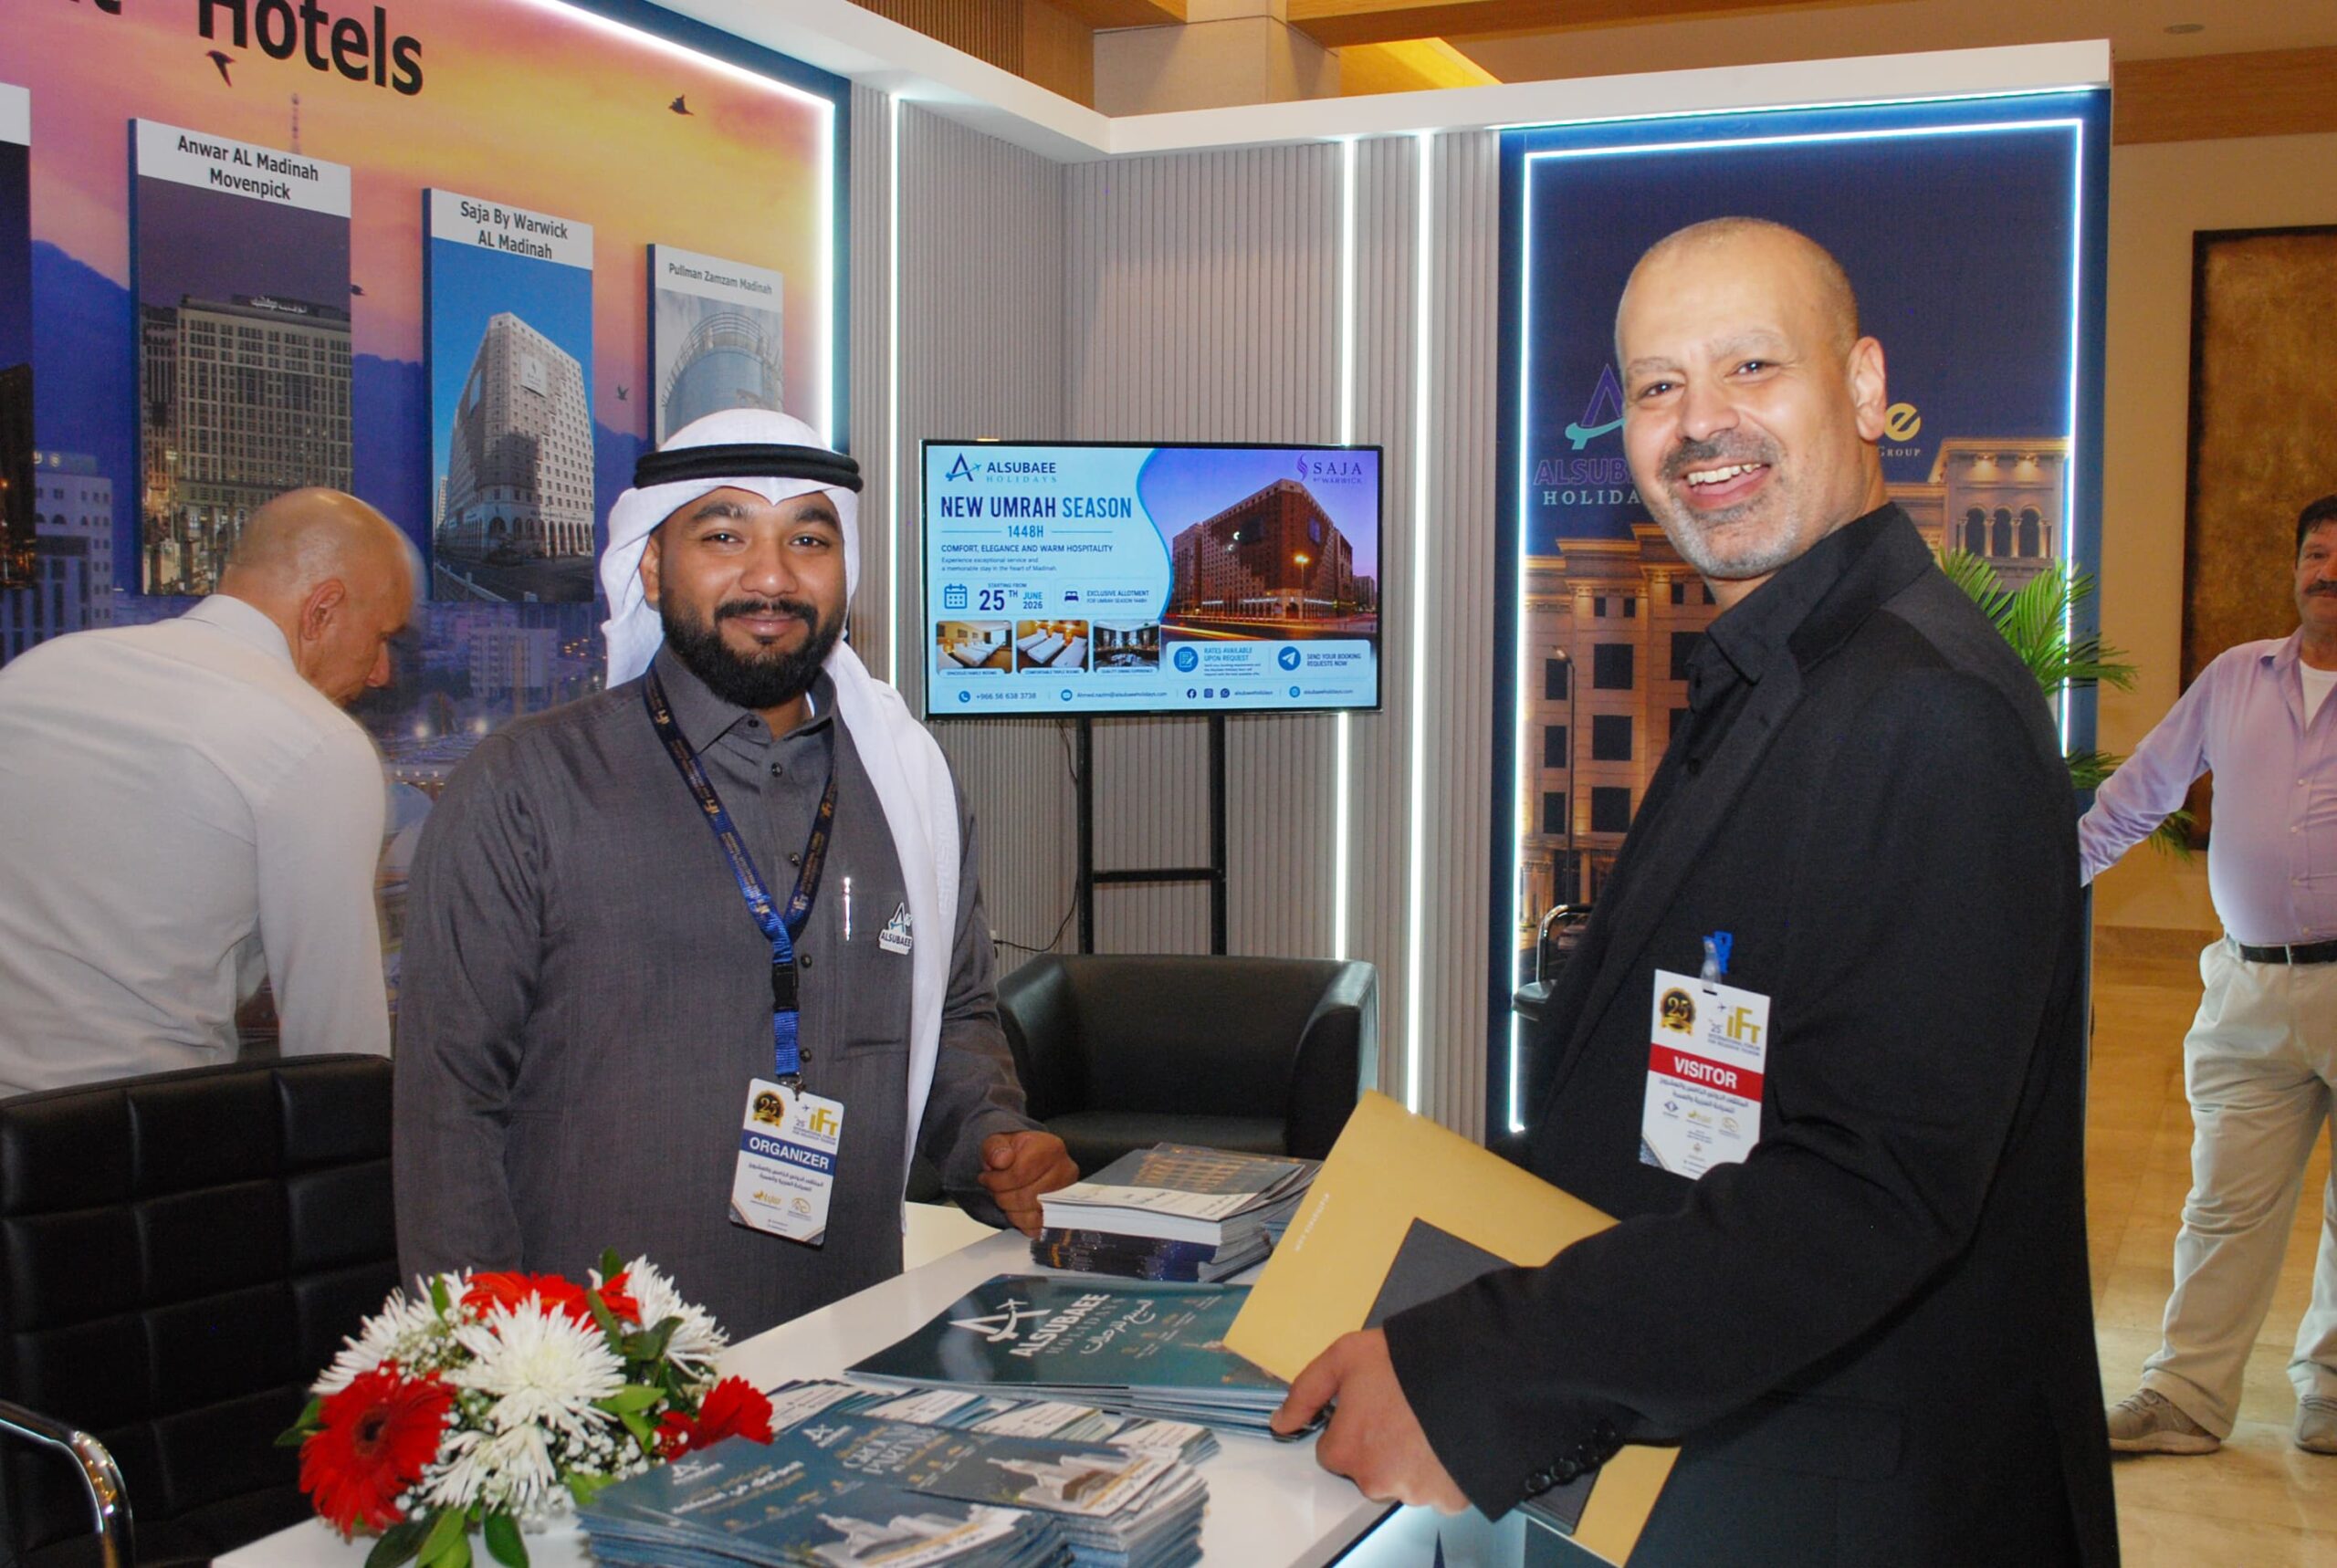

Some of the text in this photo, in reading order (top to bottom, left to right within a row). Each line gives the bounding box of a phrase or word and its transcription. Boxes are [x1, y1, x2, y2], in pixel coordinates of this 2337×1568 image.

[177, 135, 319, 182] Anwar AL Madinah
[210, 168, 291, 200] Movenpick
[460, 201, 569, 239] Saja By Warwick
[477, 230, 552, 259] AL Madinah
[704, 270, 739, 288] Zamzam
[739, 278, 772, 295] Madinah
[987, 462, 1056, 474] ALSUBAEE
[1313, 462, 1362, 475] SAJA
[1534, 458, 1635, 486] ALSUB
[987, 475, 1057, 483] HOLIDAYS
[941, 497, 1132, 518] NEW UMRAH SEASON
[1543, 490, 1641, 506] HOLIDA
[1008, 525, 1044, 538] 1448H
[981, 544, 1020, 553] ELEGANCE
[1022, 544, 1038, 553] AND
[1040, 544, 1064, 553] WARM
[1066, 545, 1114, 553] HOSPITALITY
[979, 590, 1018, 611] 25 TH
[1023, 591, 1043, 600] JUNE
[1023, 601, 1043, 609] 2026
[881, 931, 912, 947] ALSUBAEE
[1674, 1056, 1737, 1089] VISITOR
[749, 1136, 830, 1170] ORGANIZER
[1008, 1293, 1111, 1358] ALSUBAEE
